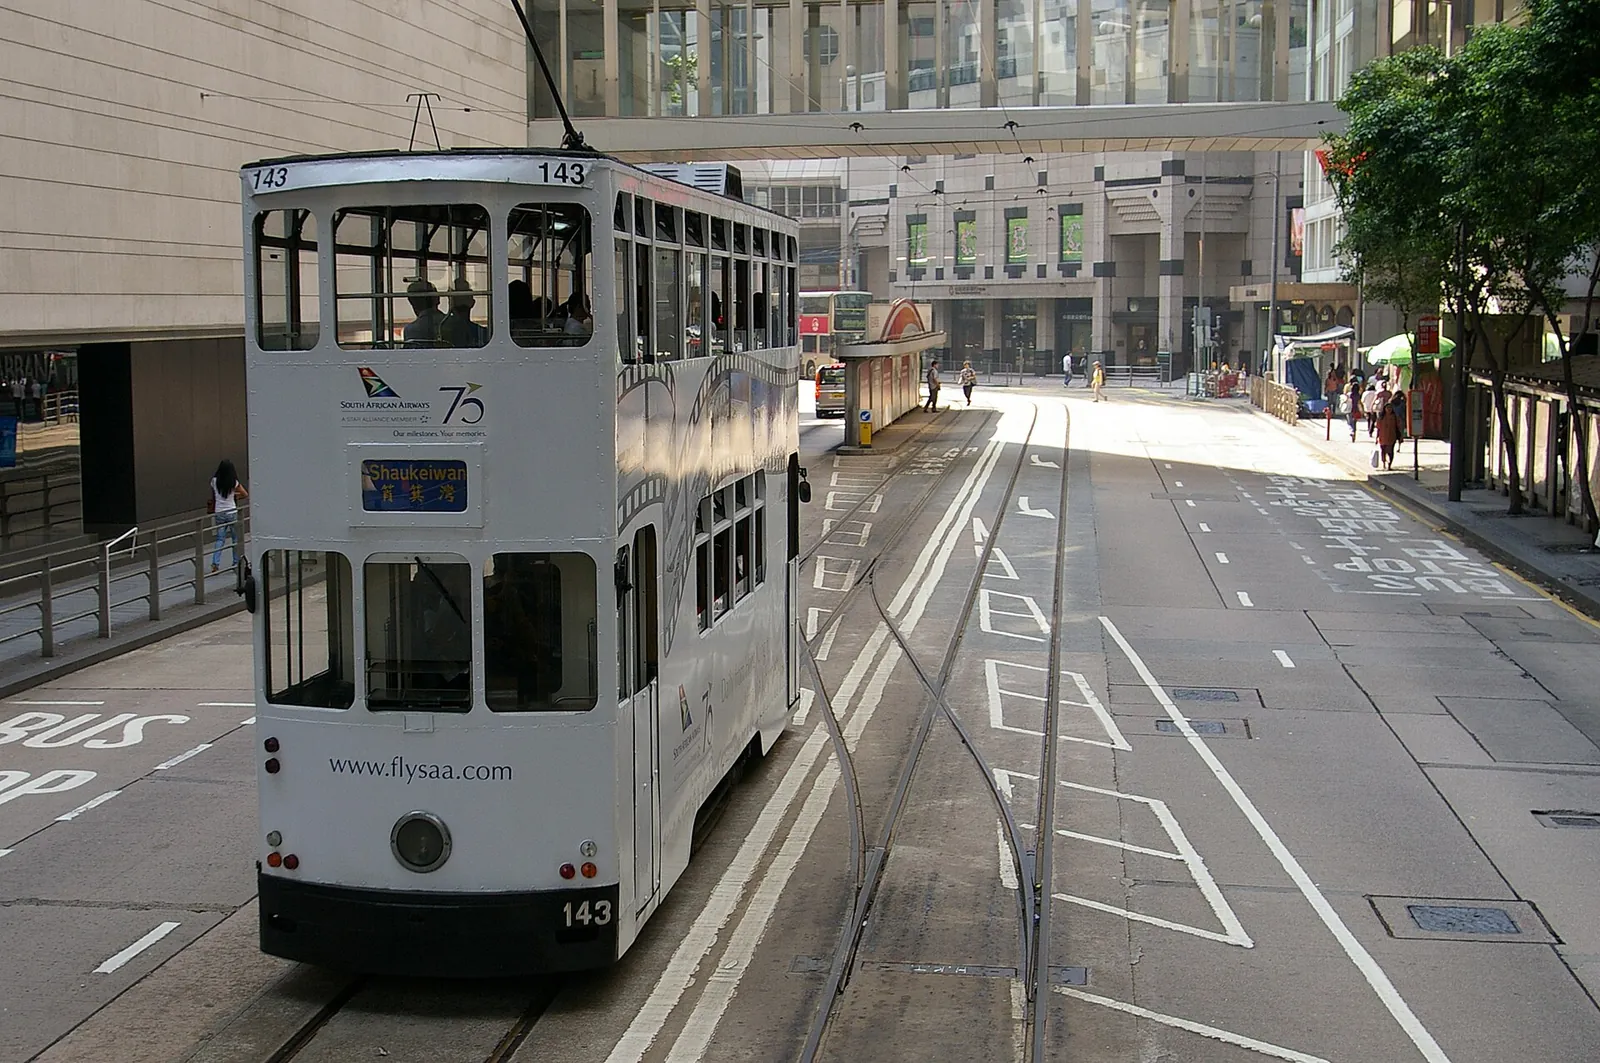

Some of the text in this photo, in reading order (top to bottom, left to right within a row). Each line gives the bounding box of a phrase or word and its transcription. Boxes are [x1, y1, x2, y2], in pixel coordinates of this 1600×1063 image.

[253, 167, 288, 190] 143
[538, 161, 586, 185] 143
[340, 401, 365, 409] SOUTH
[439, 386, 485, 424] 75
[369, 464, 466, 481] Shaukeiwan
[381, 484, 456, 503] 筲箕灣
[1333, 557, 1501, 577] STOP
[1367, 574, 1516, 595] BUS
[0, 711, 191, 749] BUS
[329, 756, 513, 785] www.flysaa.com
[563, 900, 612, 927] 143
